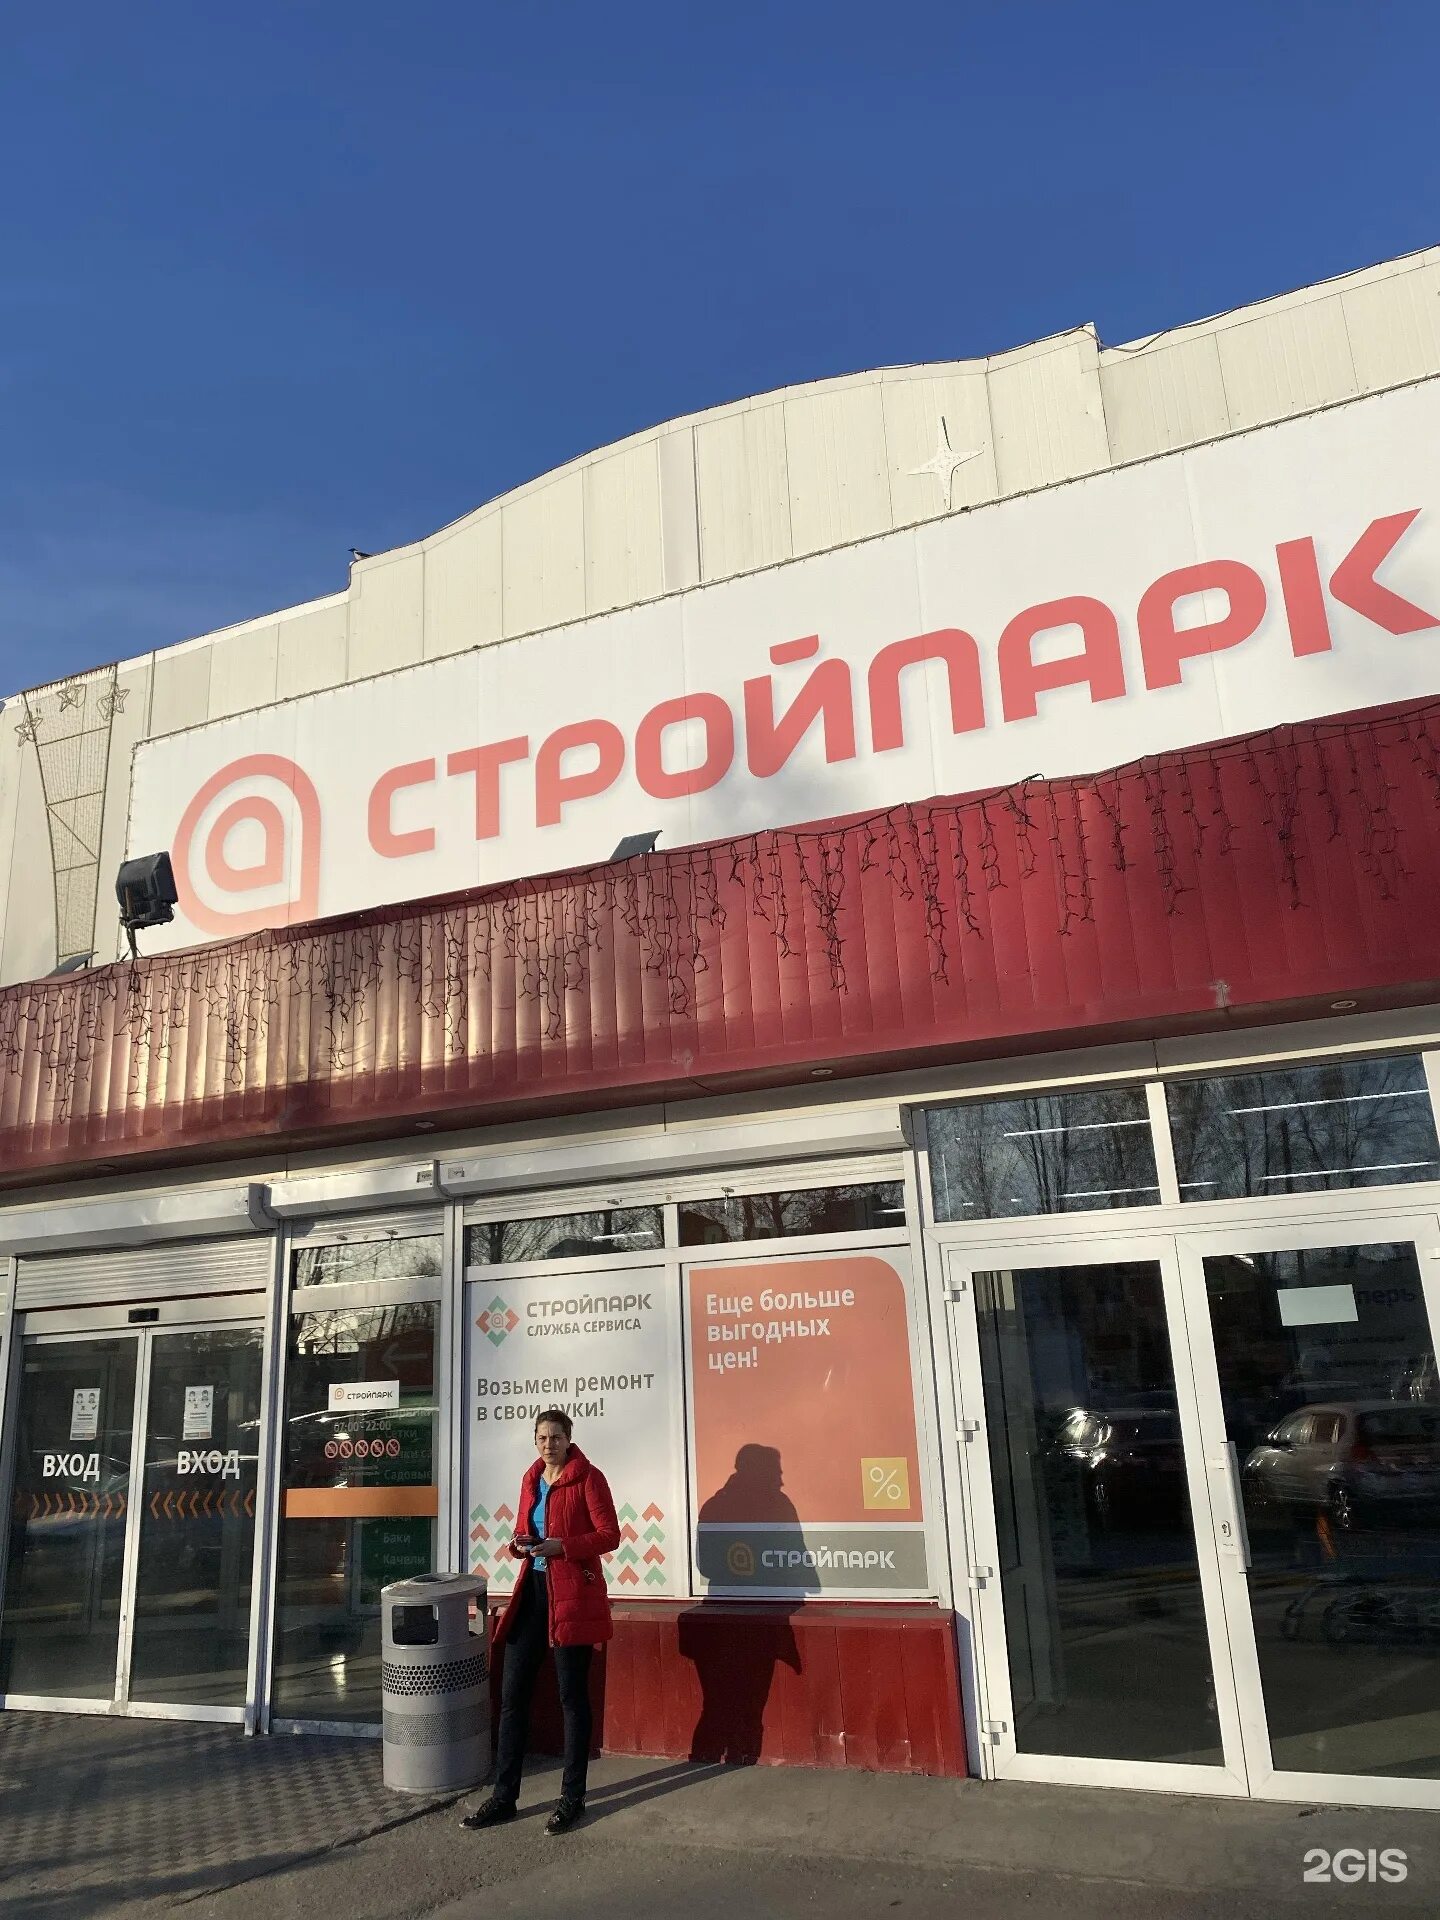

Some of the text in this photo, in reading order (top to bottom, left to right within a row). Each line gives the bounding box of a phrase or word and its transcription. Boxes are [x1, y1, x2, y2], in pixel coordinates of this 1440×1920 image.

[369, 511, 1440, 857] СТРОЙПАРК
[527, 1293, 652, 1318] СТРОЙПАРК
[706, 1287, 856, 1318] Еще больше
[527, 1318, 642, 1338] СЛУЖБА СЕРВИСА
[707, 1317, 831, 1344] выгодных
[708, 1346, 758, 1374] цен!
[347, 1390, 393, 1400] СТРОЙПАРК
[477, 1373, 655, 1397] Возьмем ремонт
[477, 1406, 488, 1421] в
[493, 1404, 541, 1420] свои
[42, 1453, 100, 1482] ВХОД
[177, 1449, 240, 1479] ВХОД
[761, 1545, 896, 1569] СТРОЙПАРК
